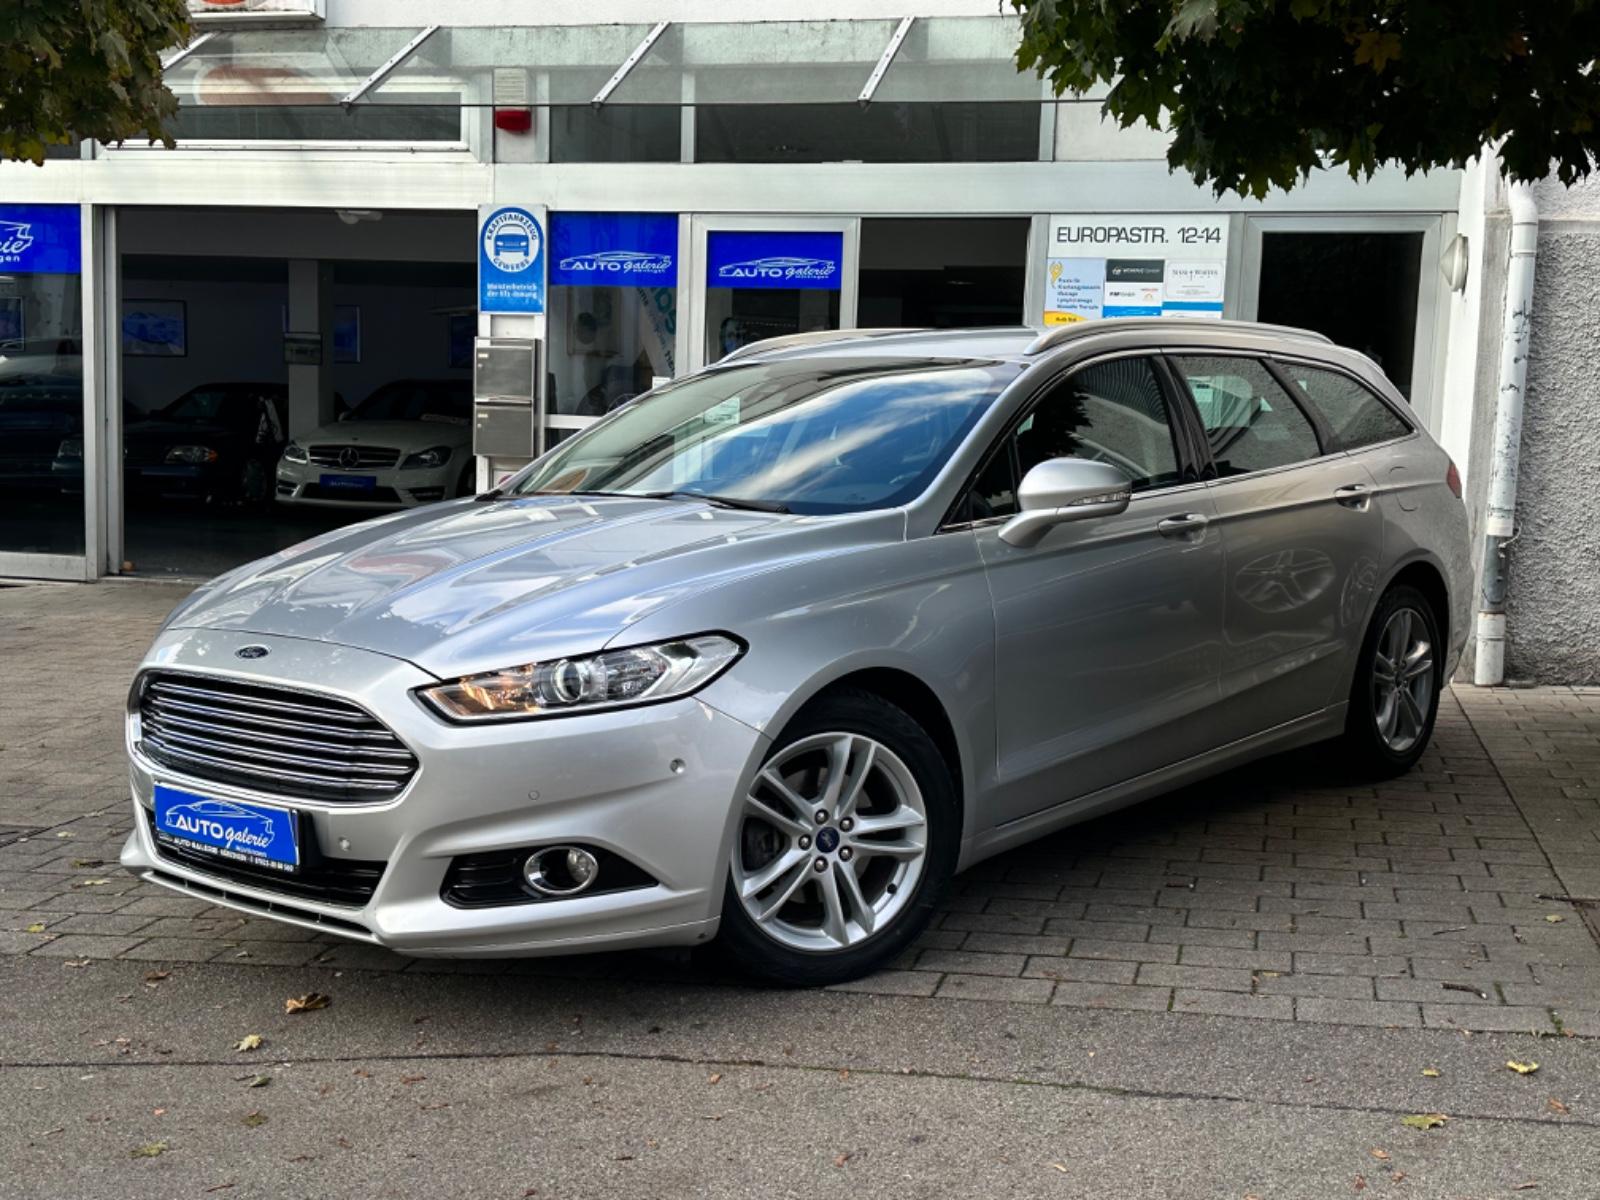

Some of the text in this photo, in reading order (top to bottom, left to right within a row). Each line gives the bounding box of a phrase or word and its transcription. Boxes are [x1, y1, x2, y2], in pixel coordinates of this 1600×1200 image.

[487, 213, 537, 240] KRAFTFAHRZEUG
[1056, 226, 1221, 244] EUROPASTR. 12-14
[493, 256, 530, 271] GEWERBE
[571, 260, 668, 274] AUTO galerie
[732, 266, 831, 280] AUTO galerie
[175, 814, 269, 849] AUTO galerie
